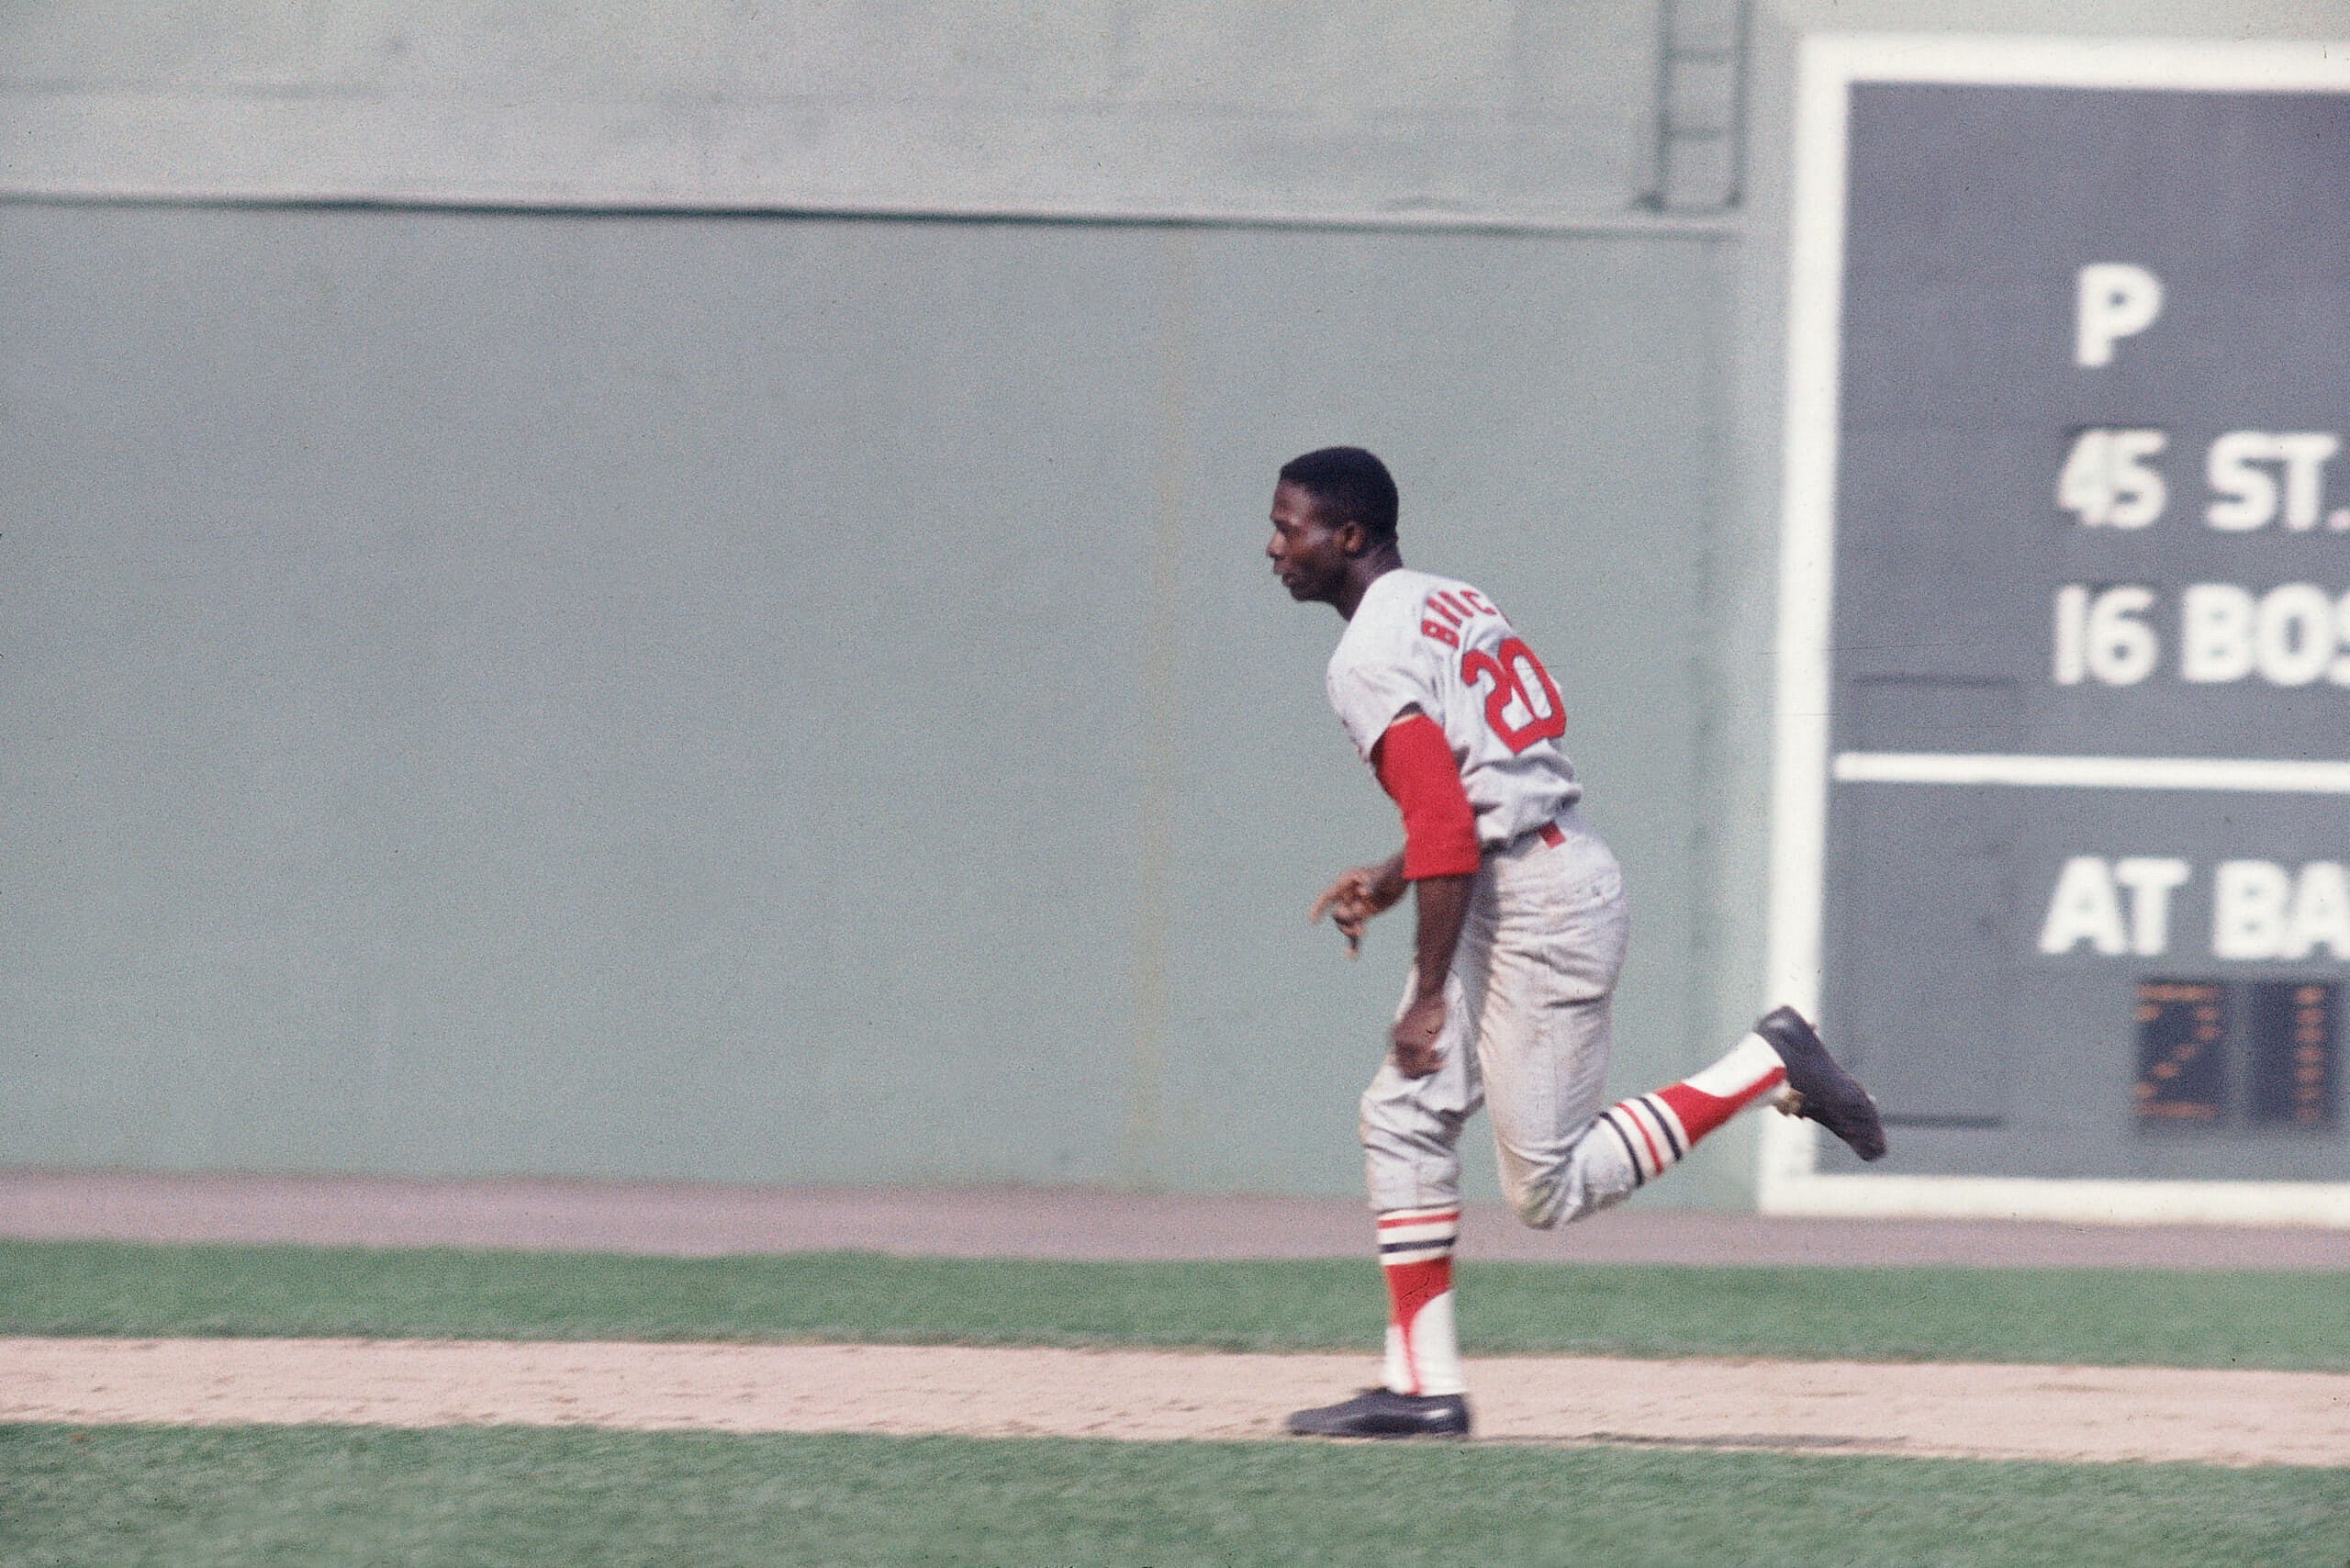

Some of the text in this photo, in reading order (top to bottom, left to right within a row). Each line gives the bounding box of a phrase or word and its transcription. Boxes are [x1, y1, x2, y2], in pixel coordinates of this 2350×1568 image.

[2076, 262, 2163, 367] P
[2057, 429, 2167, 530] 45
[2054, 584, 2158, 687] 16
[1460, 637, 1567, 754] 20
[2038, 856, 2191, 956] AT
